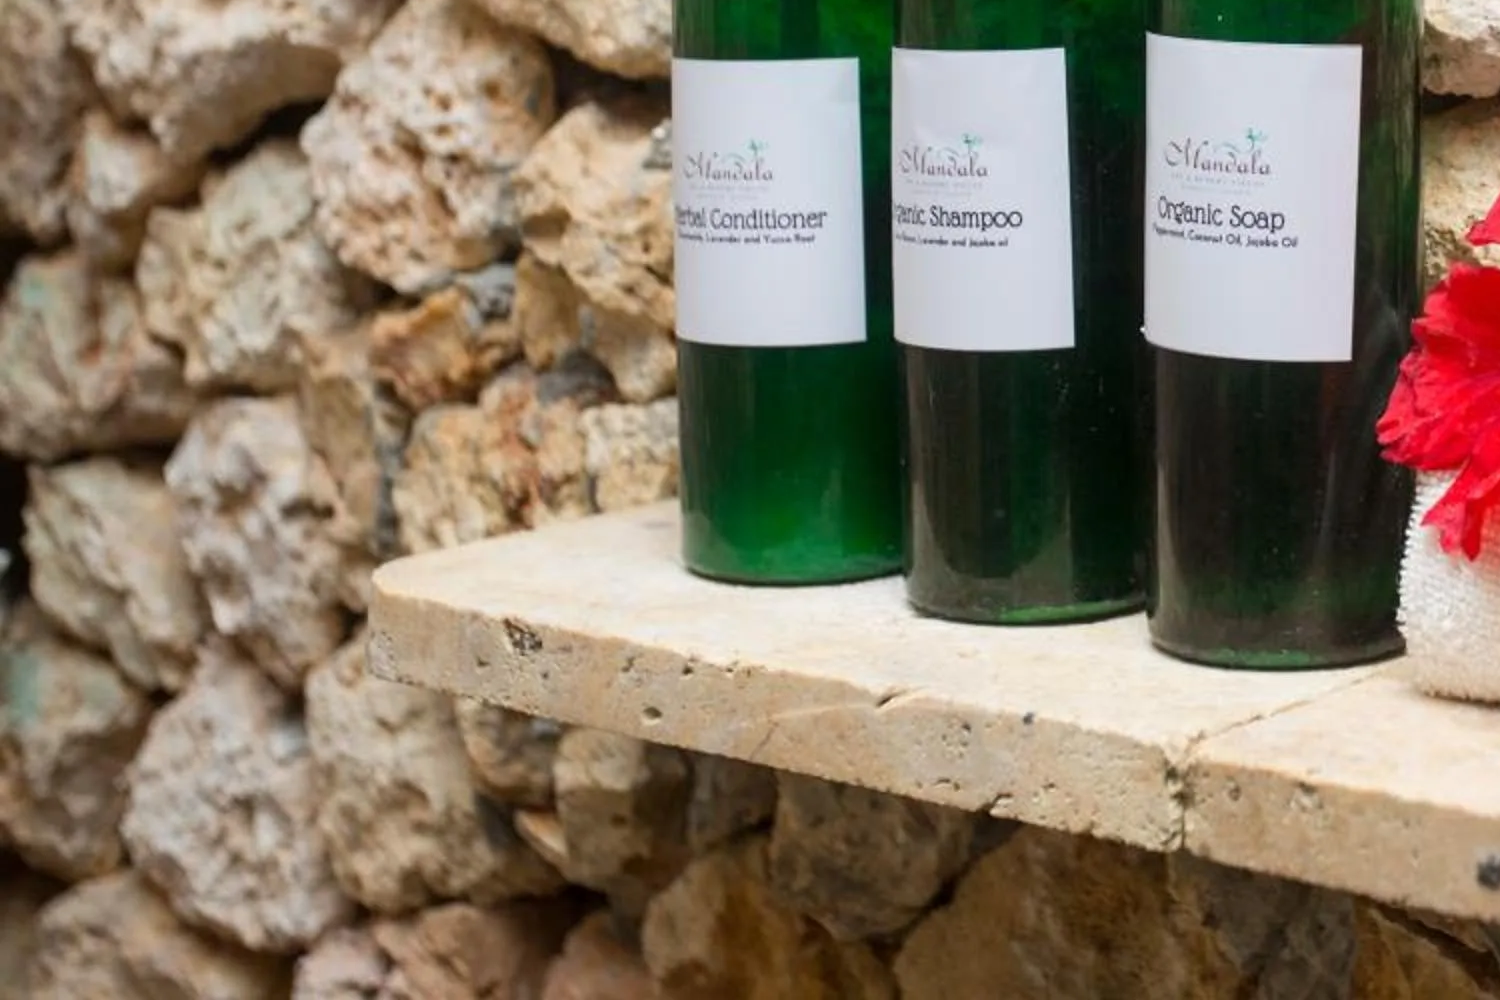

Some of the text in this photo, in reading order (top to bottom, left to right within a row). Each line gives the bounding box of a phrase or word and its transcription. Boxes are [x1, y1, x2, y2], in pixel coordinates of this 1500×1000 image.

[683, 150, 773, 181] Mandala
[899, 146, 988, 177] Mandala
[1164, 137, 1270, 175] Mandala
[675, 205, 828, 230] erbal Conditioner
[931, 204, 1023, 231] Shampoo
[1158, 195, 1285, 234] Organic Soap
